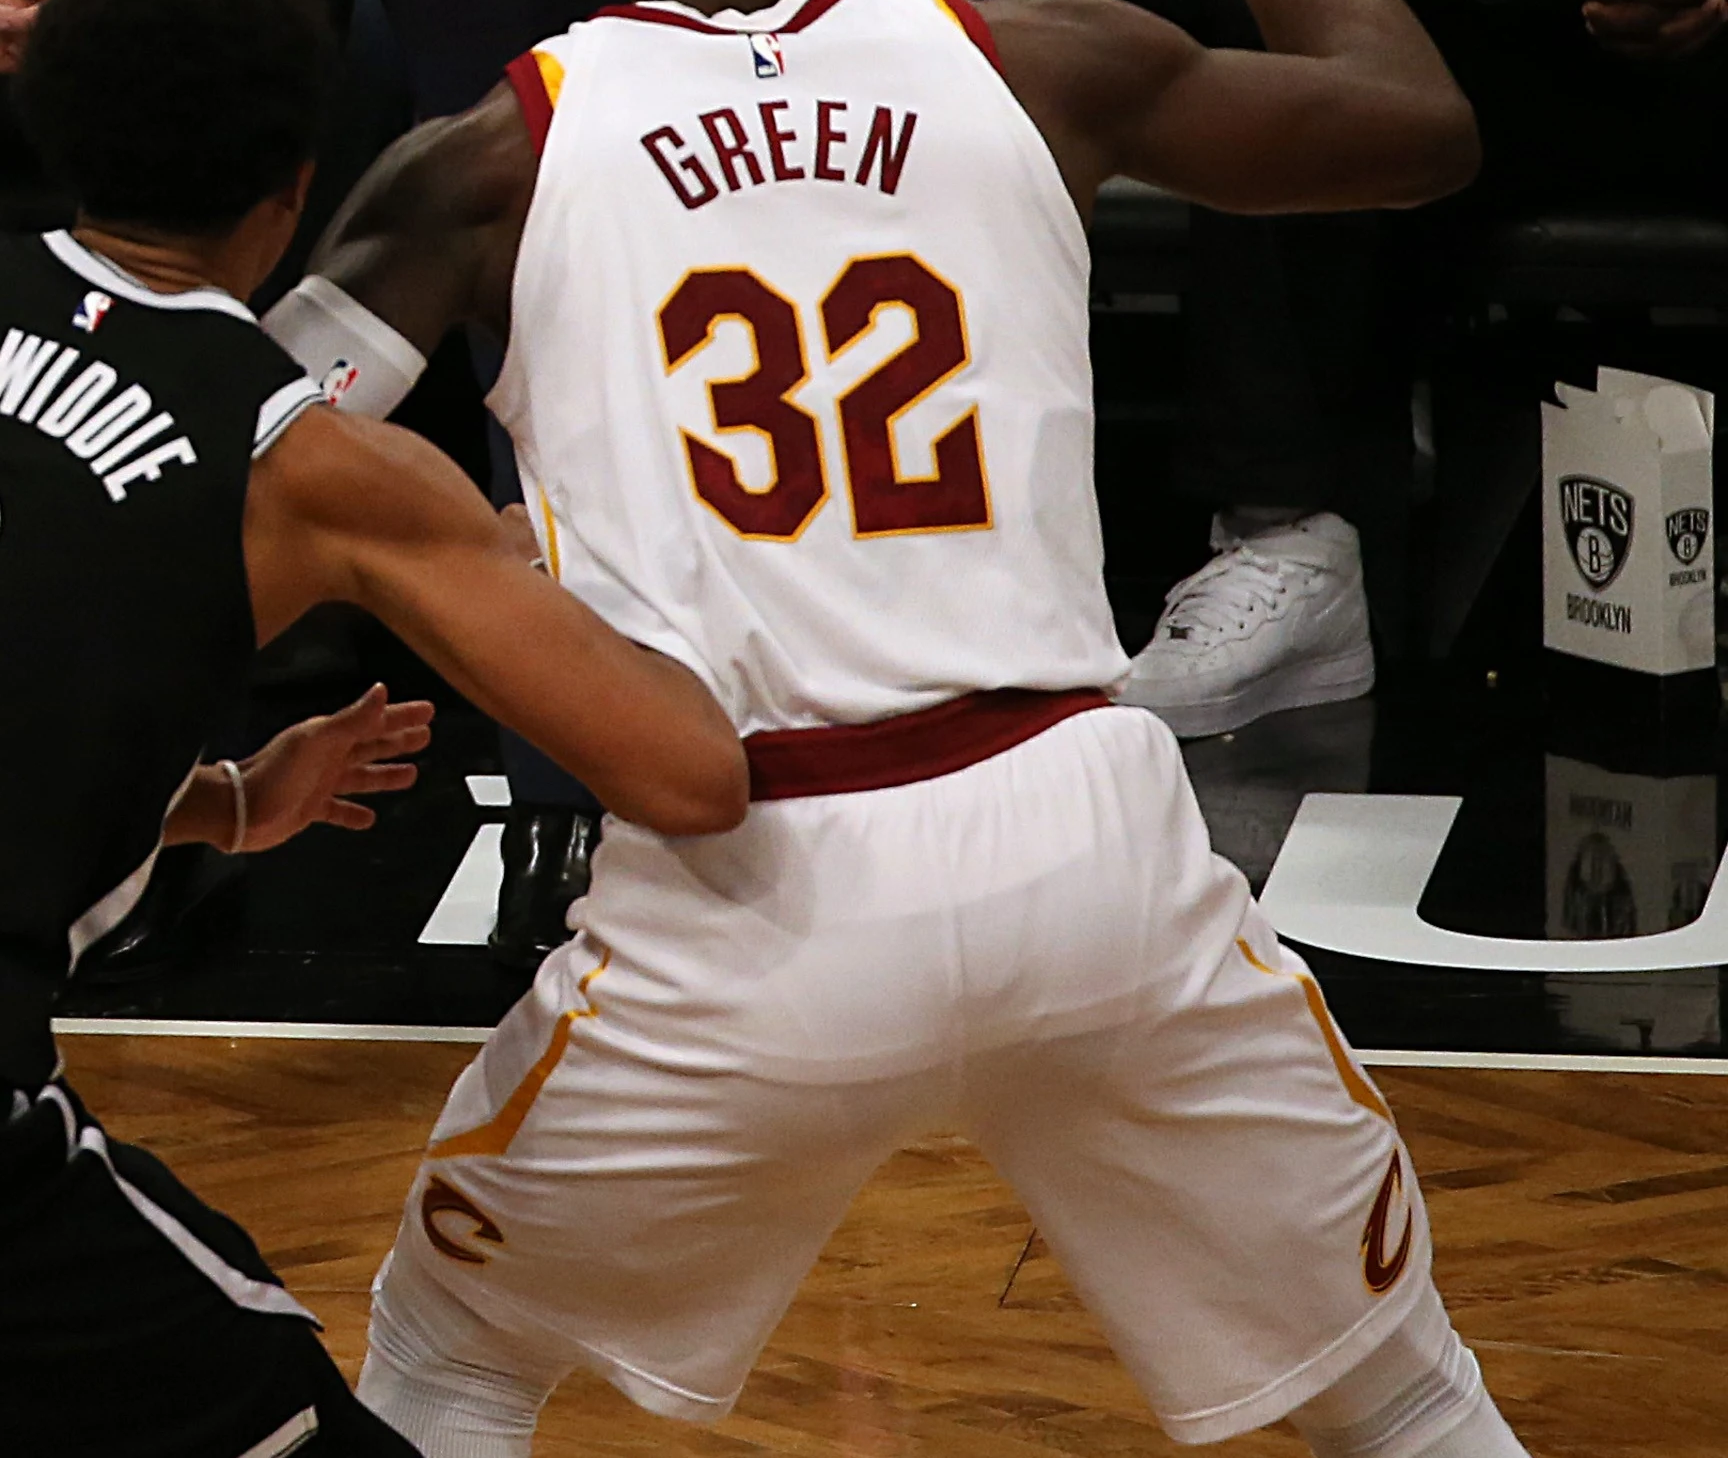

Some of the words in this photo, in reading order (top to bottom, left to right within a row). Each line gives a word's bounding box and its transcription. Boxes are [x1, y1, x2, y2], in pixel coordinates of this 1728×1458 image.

[640, 99, 919, 210] GREEN
[657, 250, 995, 543] 32
[1562, 482, 1629, 538] NETS
[1667, 511, 1708, 539] NETS
[1565, 592, 1632, 634] BROOKLYN
